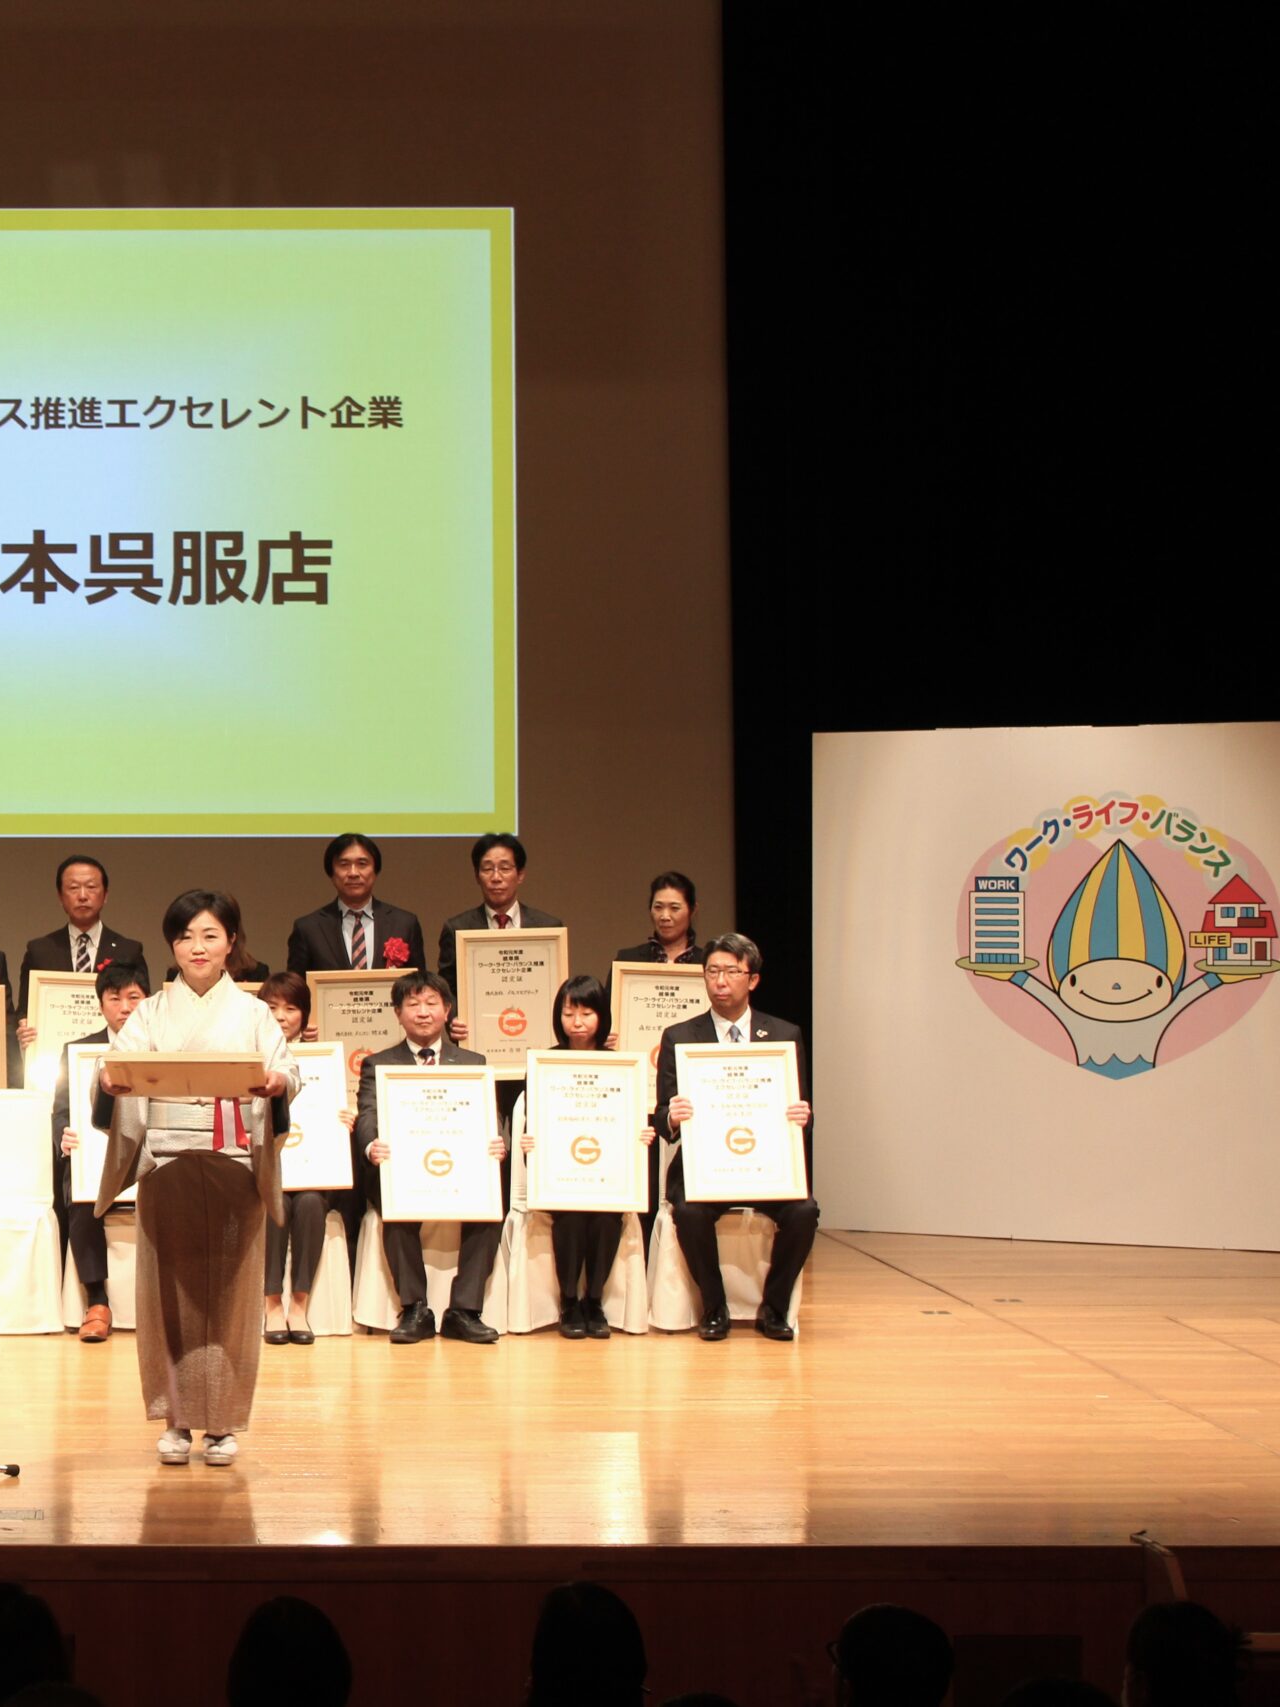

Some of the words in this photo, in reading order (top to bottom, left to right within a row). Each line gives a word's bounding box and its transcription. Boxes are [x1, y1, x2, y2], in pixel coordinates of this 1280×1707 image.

[1005, 800, 1232, 878] ワーク・ライフ・バランス
[977, 879, 1016, 891] WORK
[1193, 934, 1227, 946] LIFE
